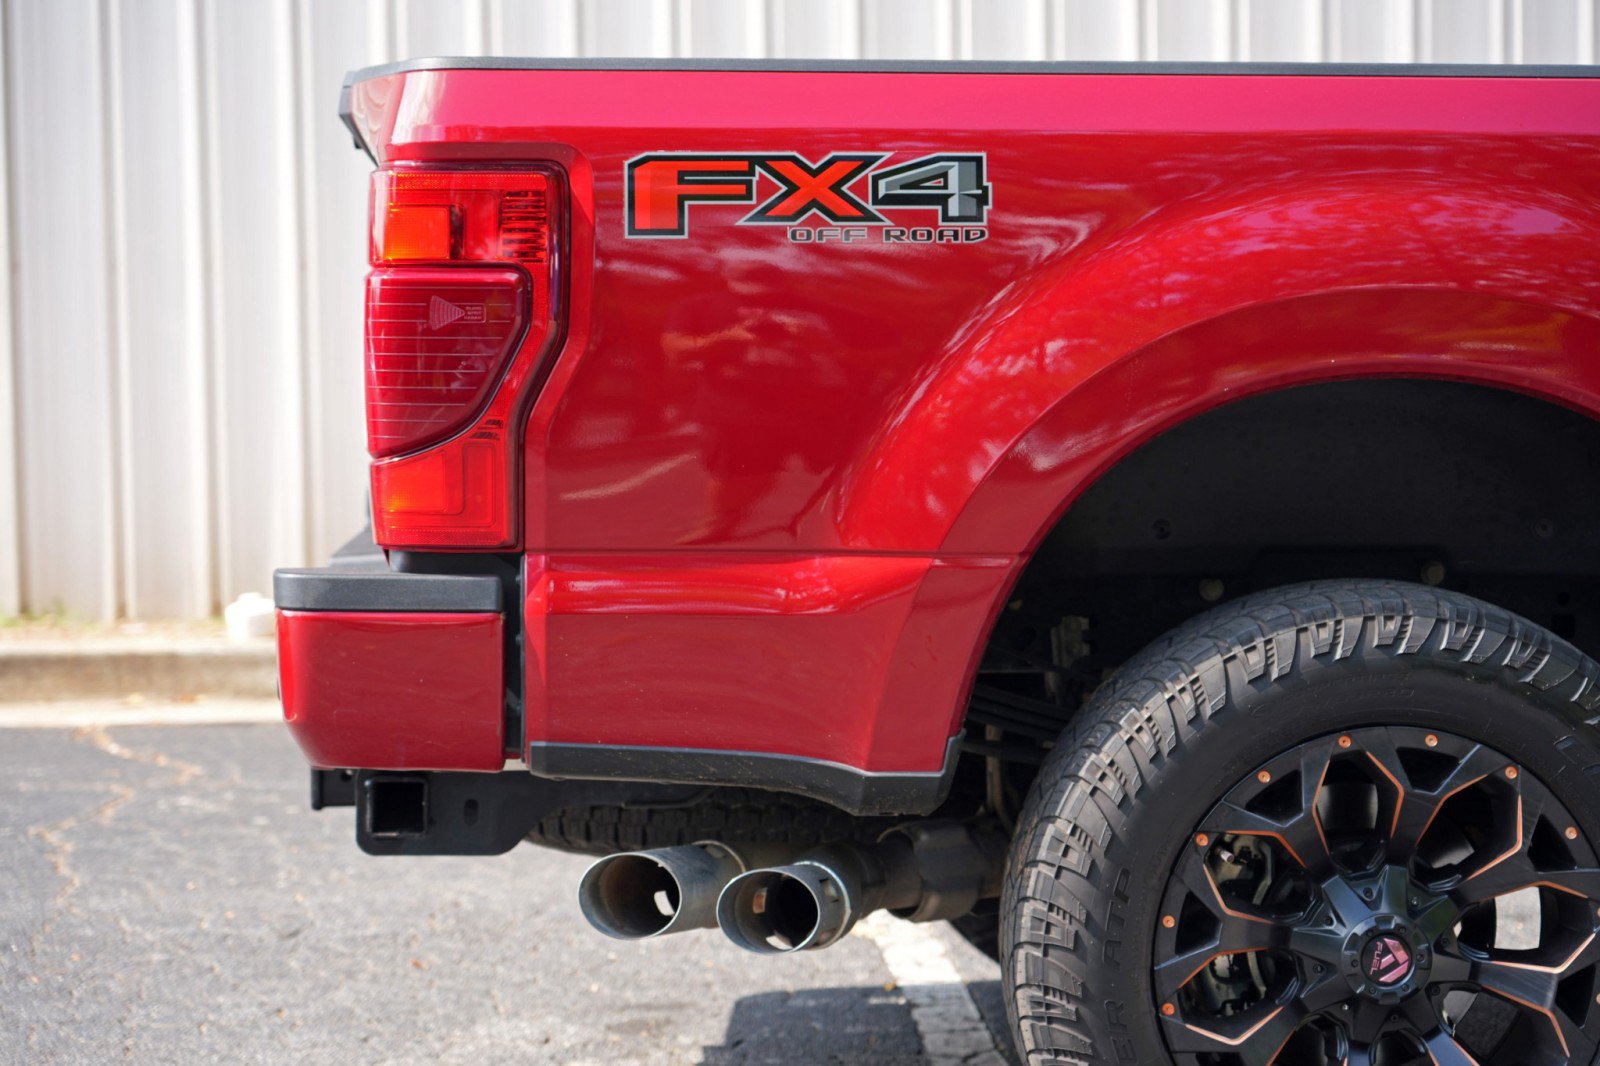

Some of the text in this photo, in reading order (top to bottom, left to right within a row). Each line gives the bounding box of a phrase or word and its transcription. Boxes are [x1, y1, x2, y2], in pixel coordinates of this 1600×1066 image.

[624, 151, 992, 239] FX4
[789, 227, 989, 244] OFF ROAD
[1102, 866, 1132, 973] ATP
[1369, 941, 1384, 975] FUEL
